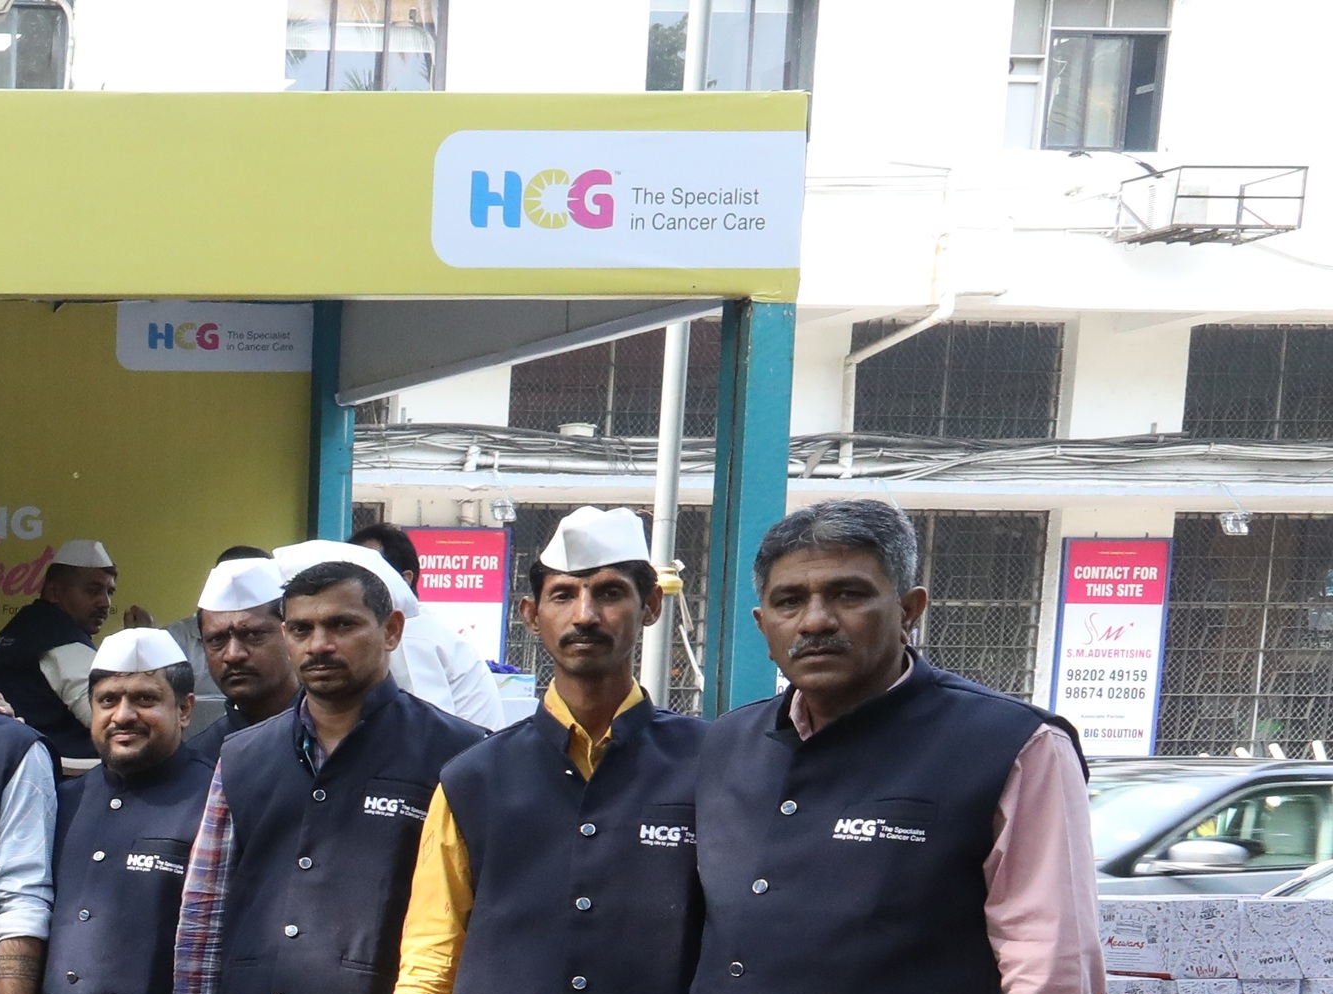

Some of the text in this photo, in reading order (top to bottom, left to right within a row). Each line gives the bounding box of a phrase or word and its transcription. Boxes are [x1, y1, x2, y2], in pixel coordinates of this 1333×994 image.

[470, 168, 614, 229] HCG
[631, 187, 759, 208] The Specialist
[630, 212, 765, 230] in Cancer Care
[148, 322, 219, 350] HCG
[227, 331, 290, 341] The Specialist
[226, 343, 294, 351] in Cancer Care
[418, 555, 498, 570] ONTACT FOR
[1074, 566, 1158, 580] CONTACT FOR
[422, 574, 484, 589] THIS SITE
[1085, 583, 1144, 597] THIS SITE
[1066, 668, 1148, 682] 98202 49159
[1065, 686, 1146, 700] 98674 02806
[1083, 728, 1144, 738] BIG SOLUTION
[363, 796, 398, 812] HCG
[639, 824, 681, 841] HCG
[834, 818, 877, 836] HCG
[894, 826, 925, 836] Specialist
[886, 833, 910, 841] Cancer
[126, 853, 154, 868] HCG
